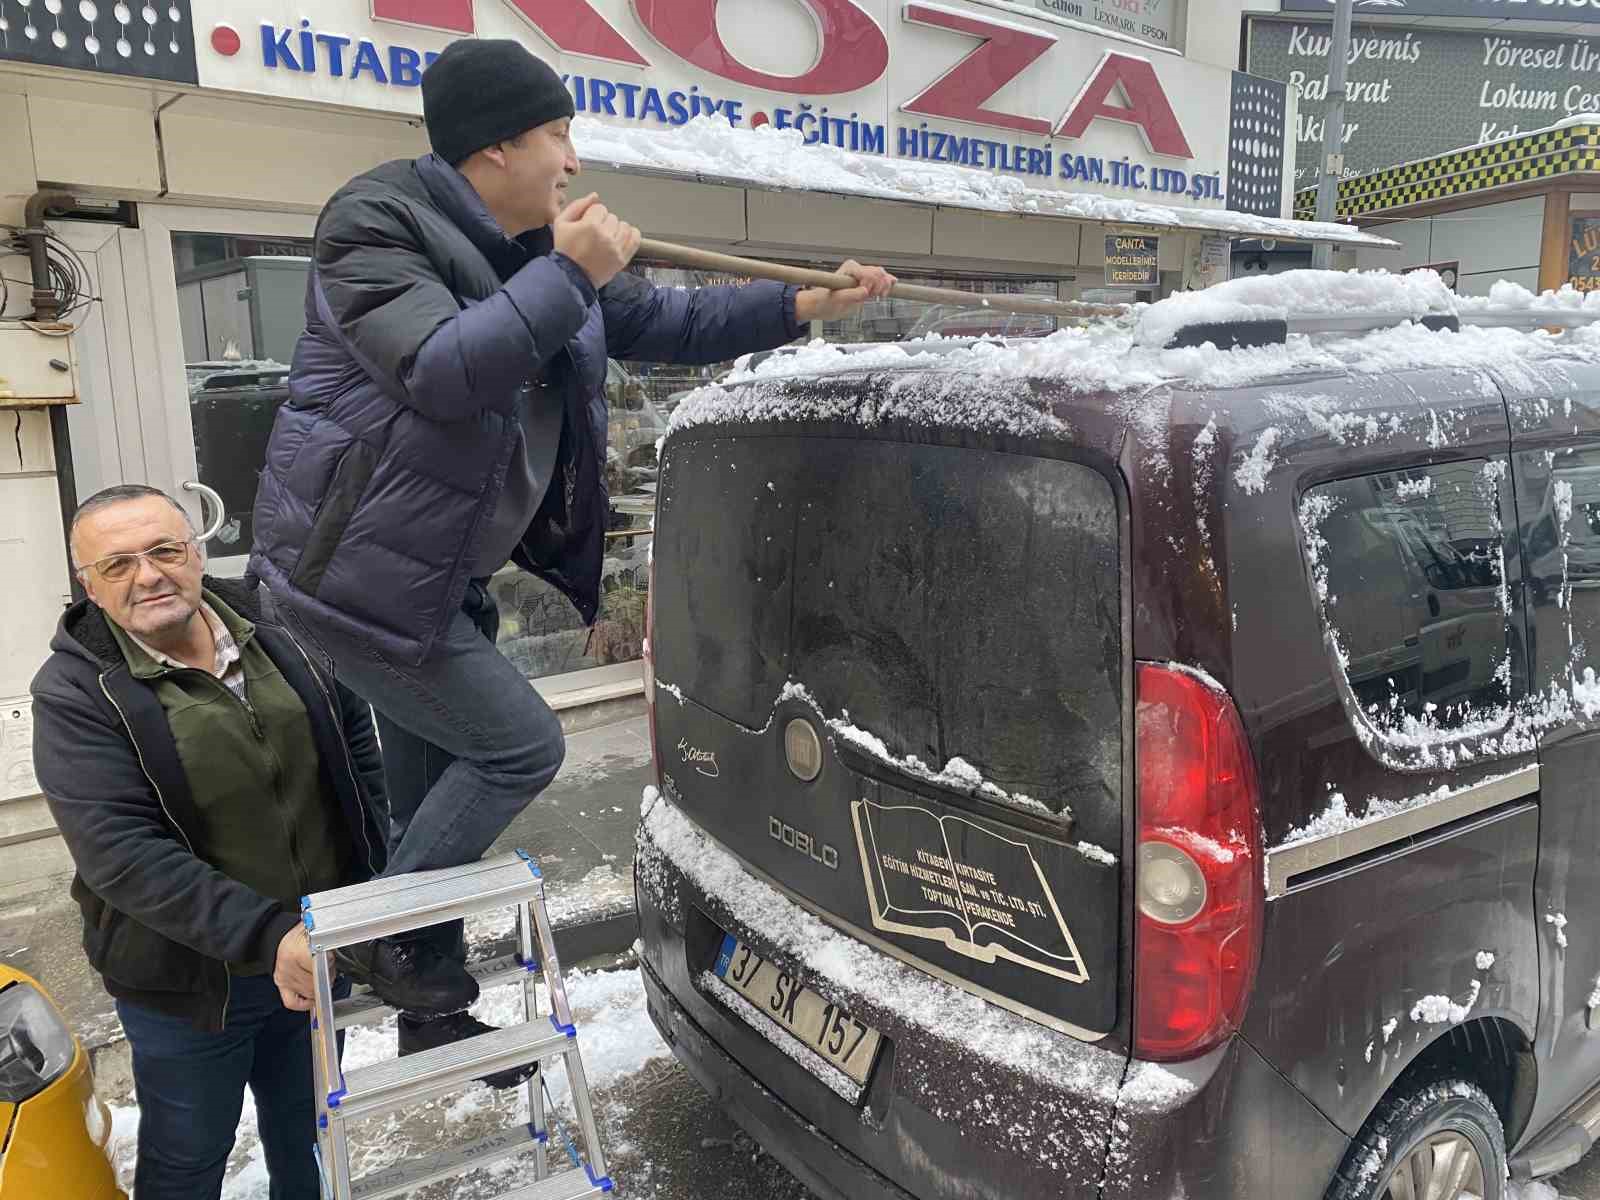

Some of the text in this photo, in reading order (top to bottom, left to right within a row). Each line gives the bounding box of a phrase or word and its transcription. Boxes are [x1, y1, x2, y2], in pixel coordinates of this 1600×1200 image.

[1141, 24, 1168, 41] EPSON
[1287, 25, 1422, 64] Kuryemiş
[1481, 36, 1565, 70] Yöresel
[368, 0, 1194, 161] OZA
[1479, 79, 1558, 110] Lokum
[561, 74, 743, 128] IRTASİYE
[897, 122, 1053, 177] HİZMETLERİ
[768, 814, 839, 871] DOBLO
[882, 853, 910, 876] EĞİTİM
[954, 862, 997, 886] KIRTASİYE
[921, 885, 955, 909] TOPTAN
[964, 900, 1016, 928] PERAKENDE
[720, 953, 729, 966] TR
[732, 945, 868, 1064] 37 SK 157
